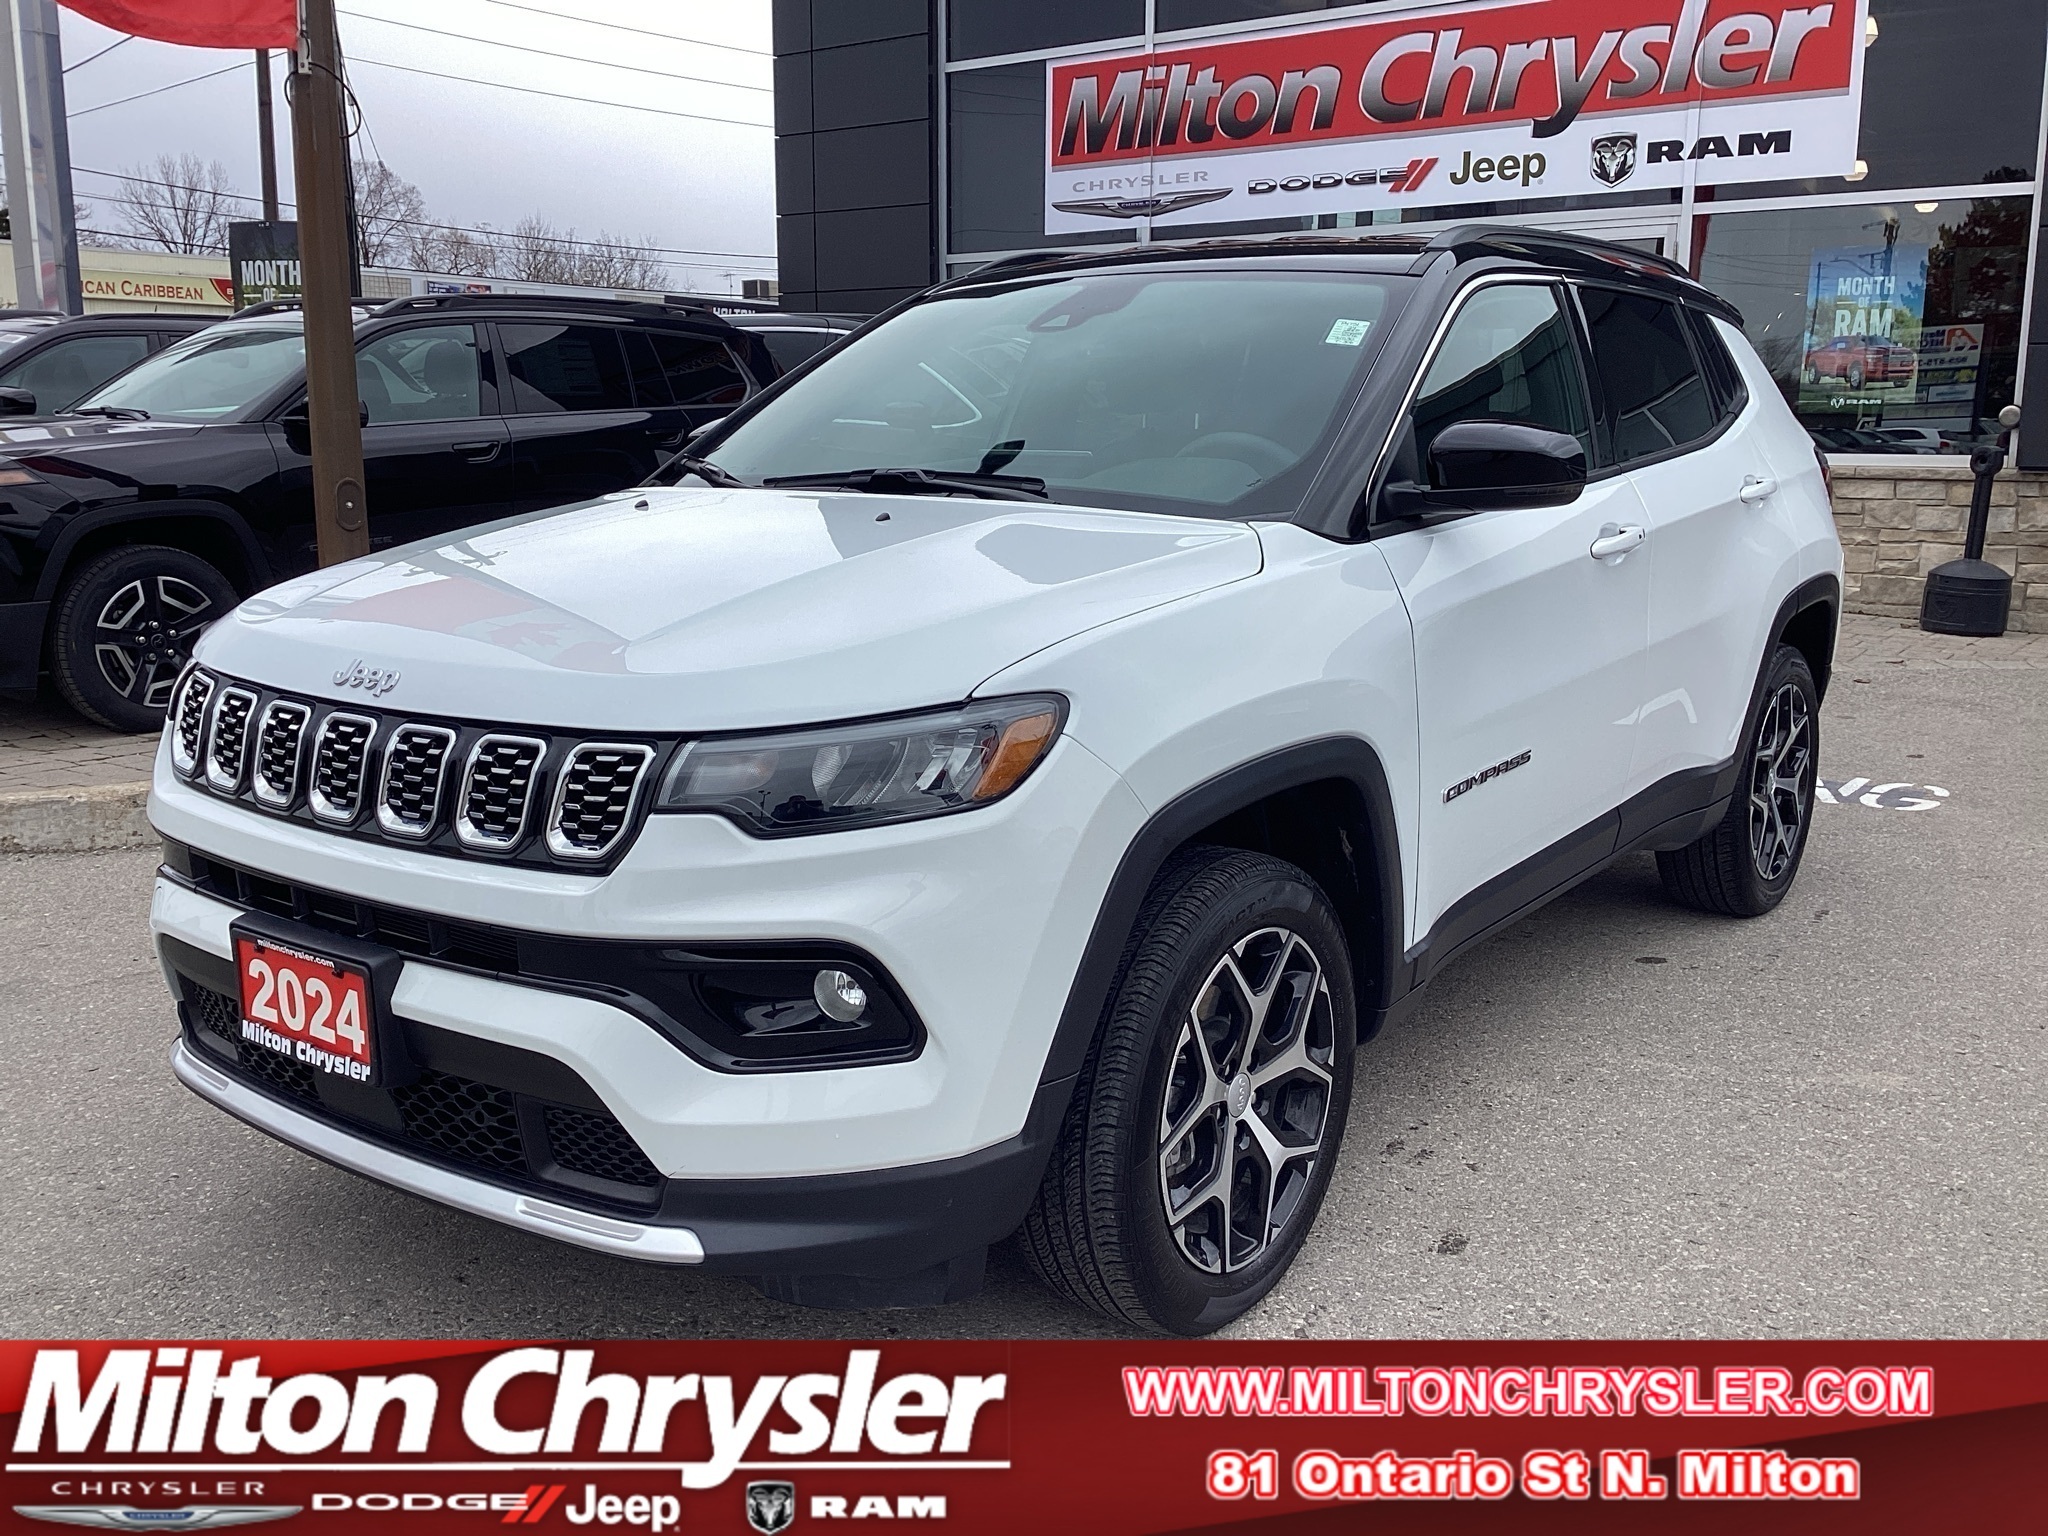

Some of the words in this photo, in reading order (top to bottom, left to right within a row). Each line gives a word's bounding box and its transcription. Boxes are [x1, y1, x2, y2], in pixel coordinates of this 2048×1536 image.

[1058, 63, 1342, 156] Milton
[1359, 0, 1833, 138] Chrysler
[1646, 130, 1792, 164] RAM
[1072, 170, 1210, 193] CHRYSLER
[1247, 165, 1412, 195] DODGE
[1450, 151, 1546, 186] Jeep
[241, 260, 301, 286] MONTH
[1837, 275, 1896, 296] MONTH
[1858, 296, 1871, 308] OF
[1834, 309, 1893, 338] RAM
[333, 659, 401, 697] Jeep
[1441, 747, 1532, 803] COMPASS
[257, 939, 335, 968] miltonchrysler.com
[248, 958, 366, 1055] 2024
[242, 1020, 291, 1056] Milton
[296, 1041, 371, 1082] Chrysler
